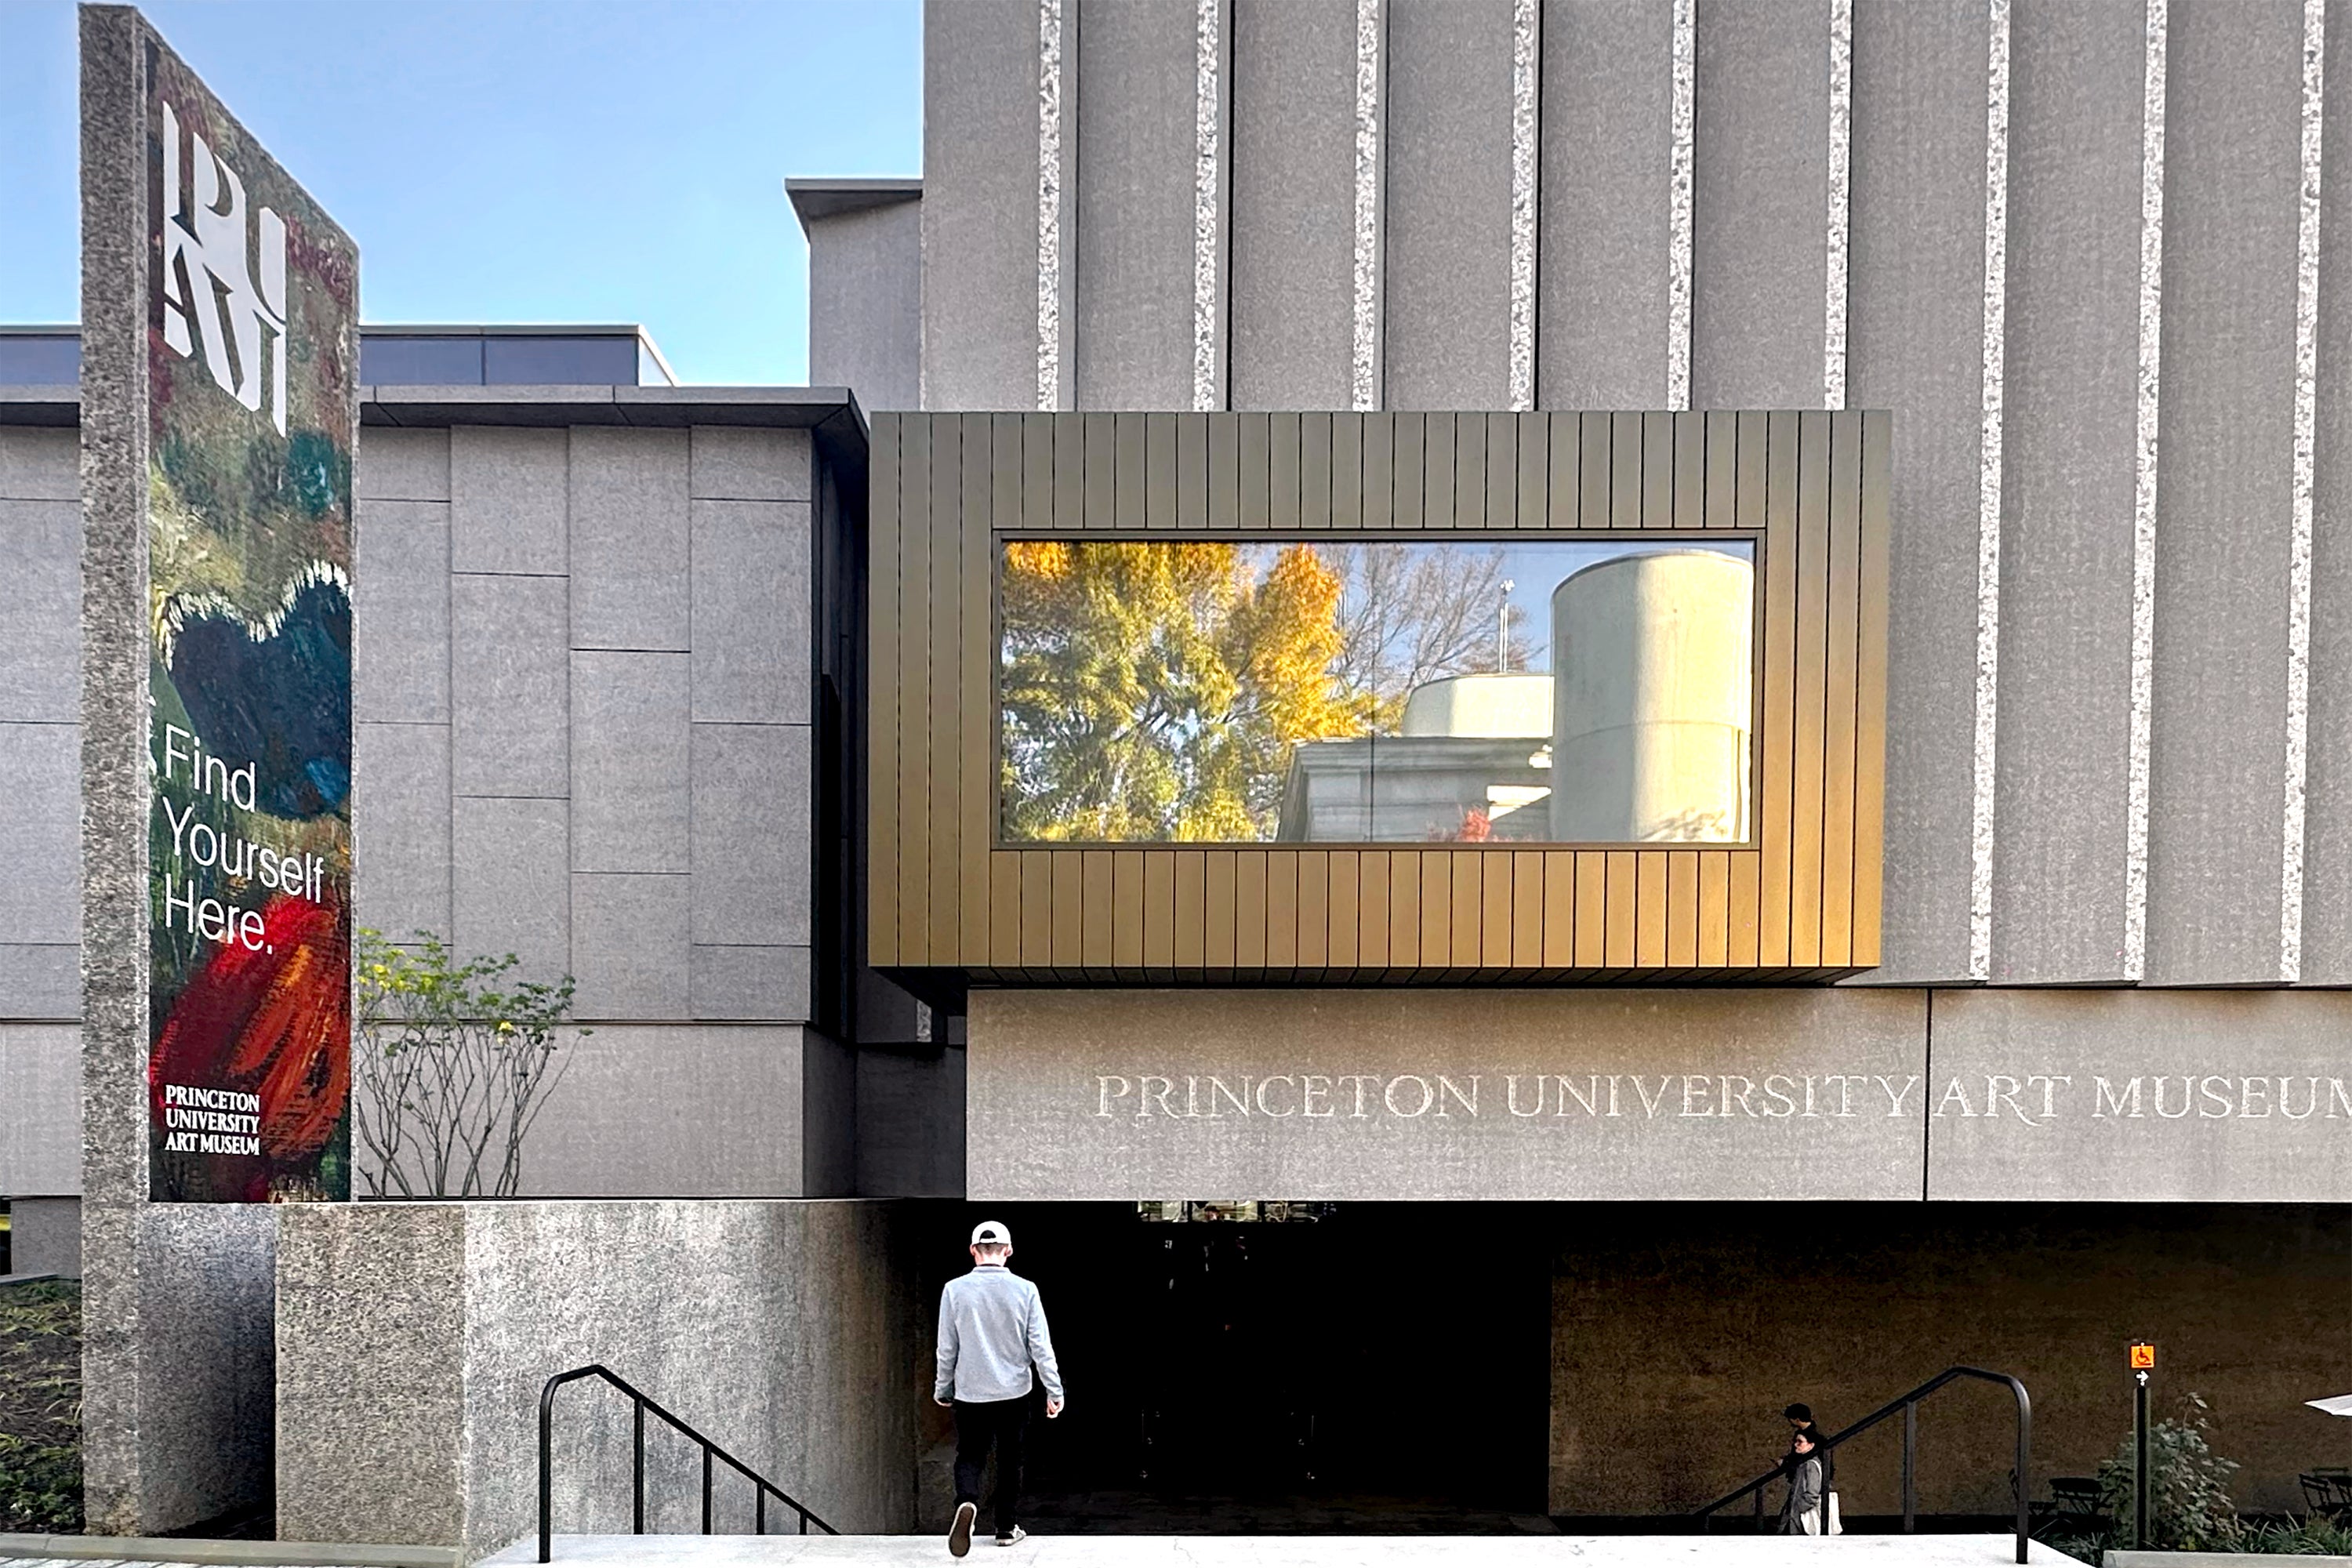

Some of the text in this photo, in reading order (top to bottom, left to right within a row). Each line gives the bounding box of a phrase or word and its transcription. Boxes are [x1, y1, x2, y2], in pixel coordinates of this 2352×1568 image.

[165, 723, 256, 812] Find
[162, 796, 324, 903] Yourself
[165, 873, 272, 954] Here.
[165, 1084, 260, 1112] PRINCETON
[165, 1108, 260, 1134] UNIVERSITY
[1094, 1073, 1479, 1119] PRINCETON
[1506, 1073, 1918, 1119] UNIVERSITY
[1931, 1074, 2072, 1127] ART
[165, 1131, 260, 1156] ART MUSEUM
